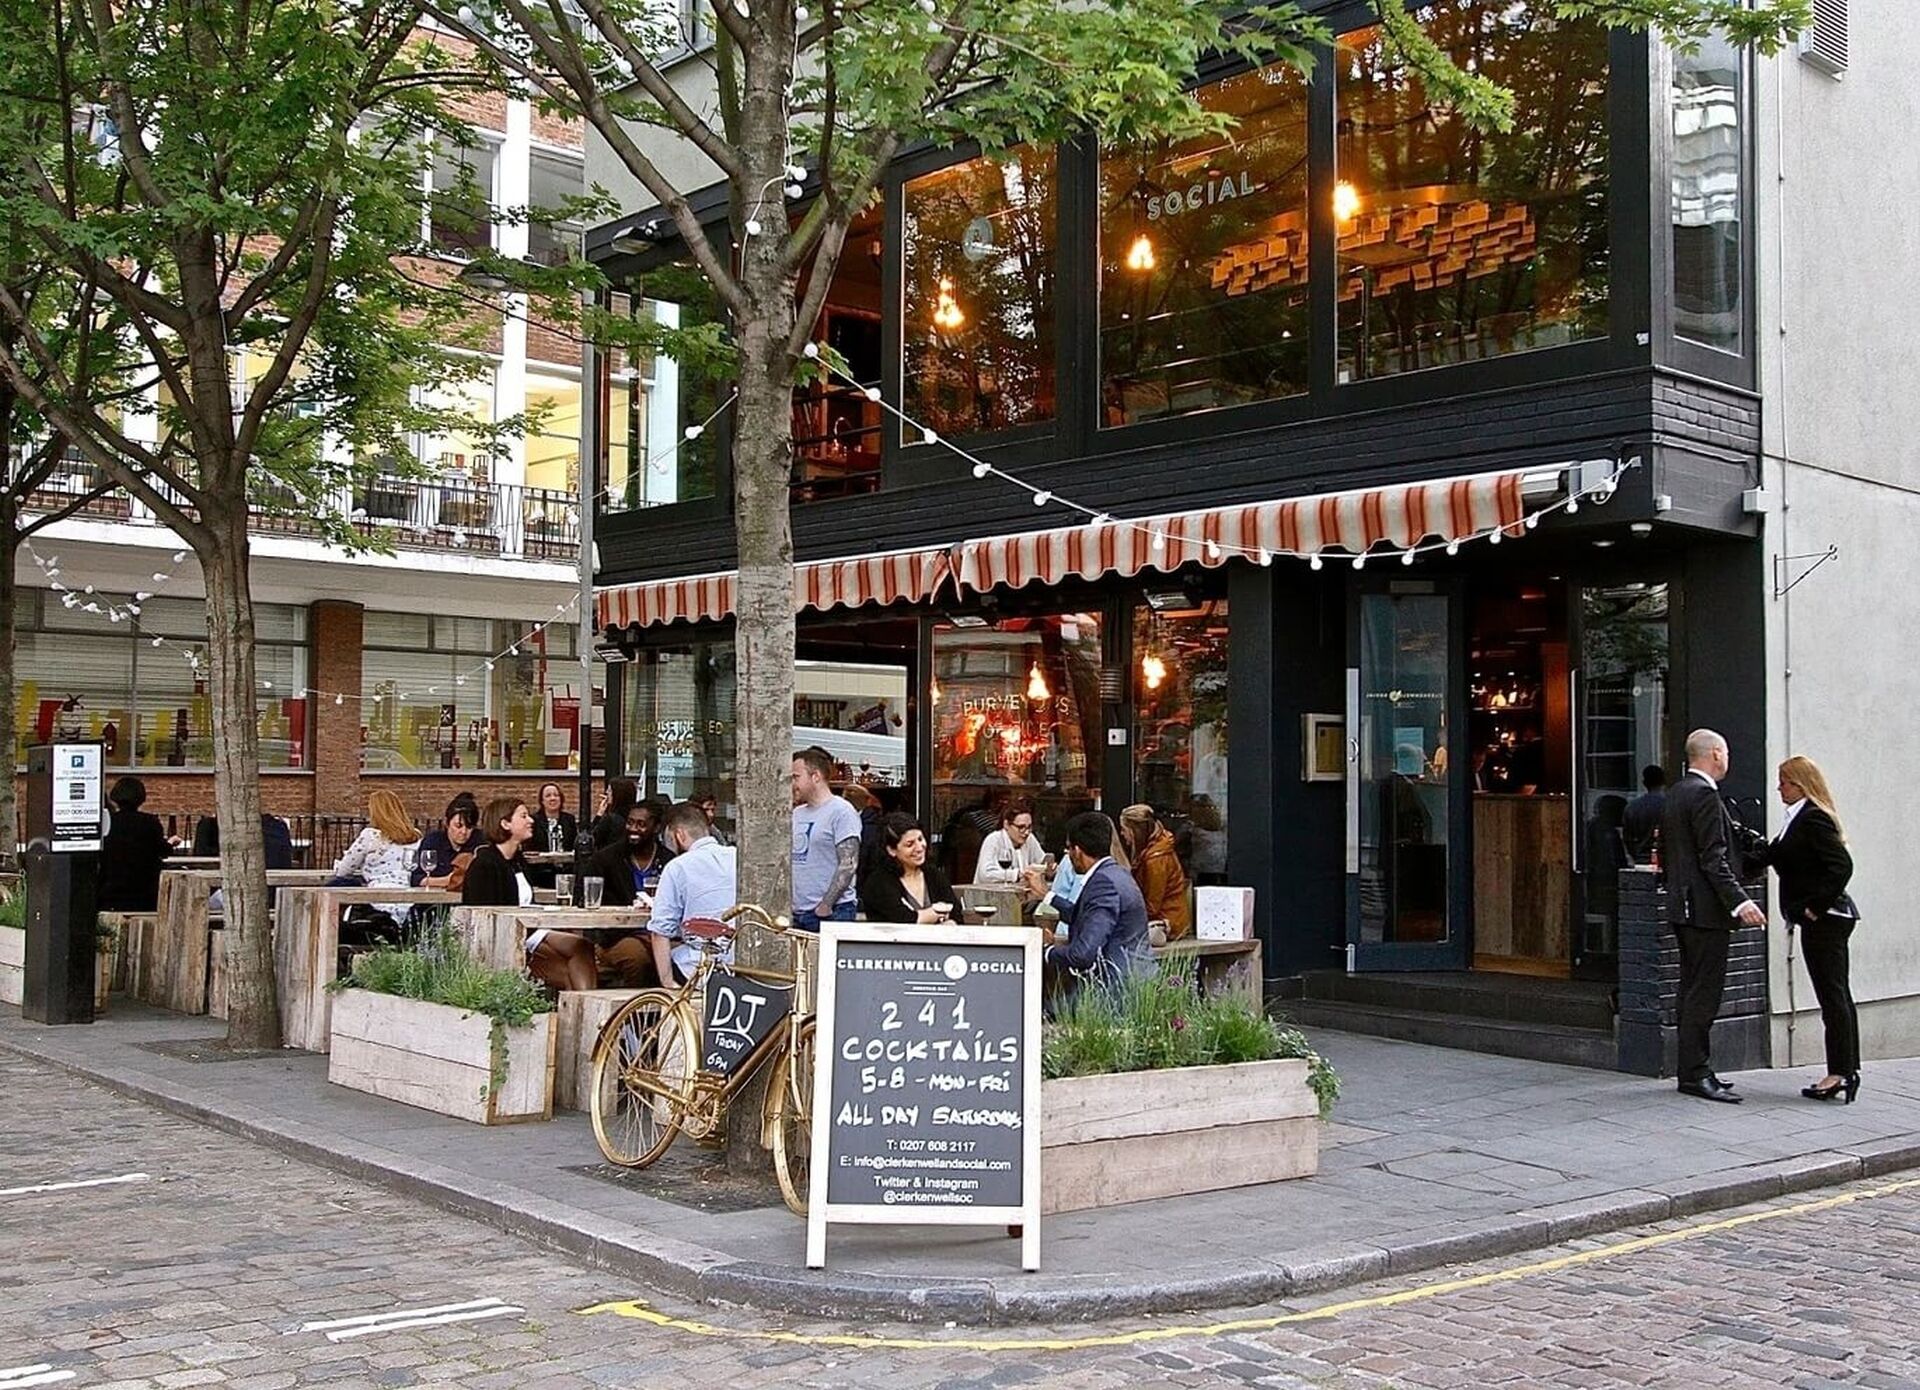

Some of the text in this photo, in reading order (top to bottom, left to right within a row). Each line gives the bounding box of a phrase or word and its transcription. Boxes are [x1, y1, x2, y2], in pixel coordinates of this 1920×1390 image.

[1147, 171, 1255, 221] SOCIAL
[837, 958, 942, 972] CLERKENWELL
[970, 961, 1023, 974] SOCIAL
[710, 986, 767, 1034] DJ
[881, 995, 971, 1031] 2 4 1
[861, 1066, 905, 1093] 5-8
[836, 1101, 874, 1126] ALL
[881, 1105, 919, 1127] DAY
[886, 1139, 976, 1152] T: 0207 608 2117
[840, 1156, 852, 1167] E:
[874, 1176, 979, 1191] Twitter & Instagram
